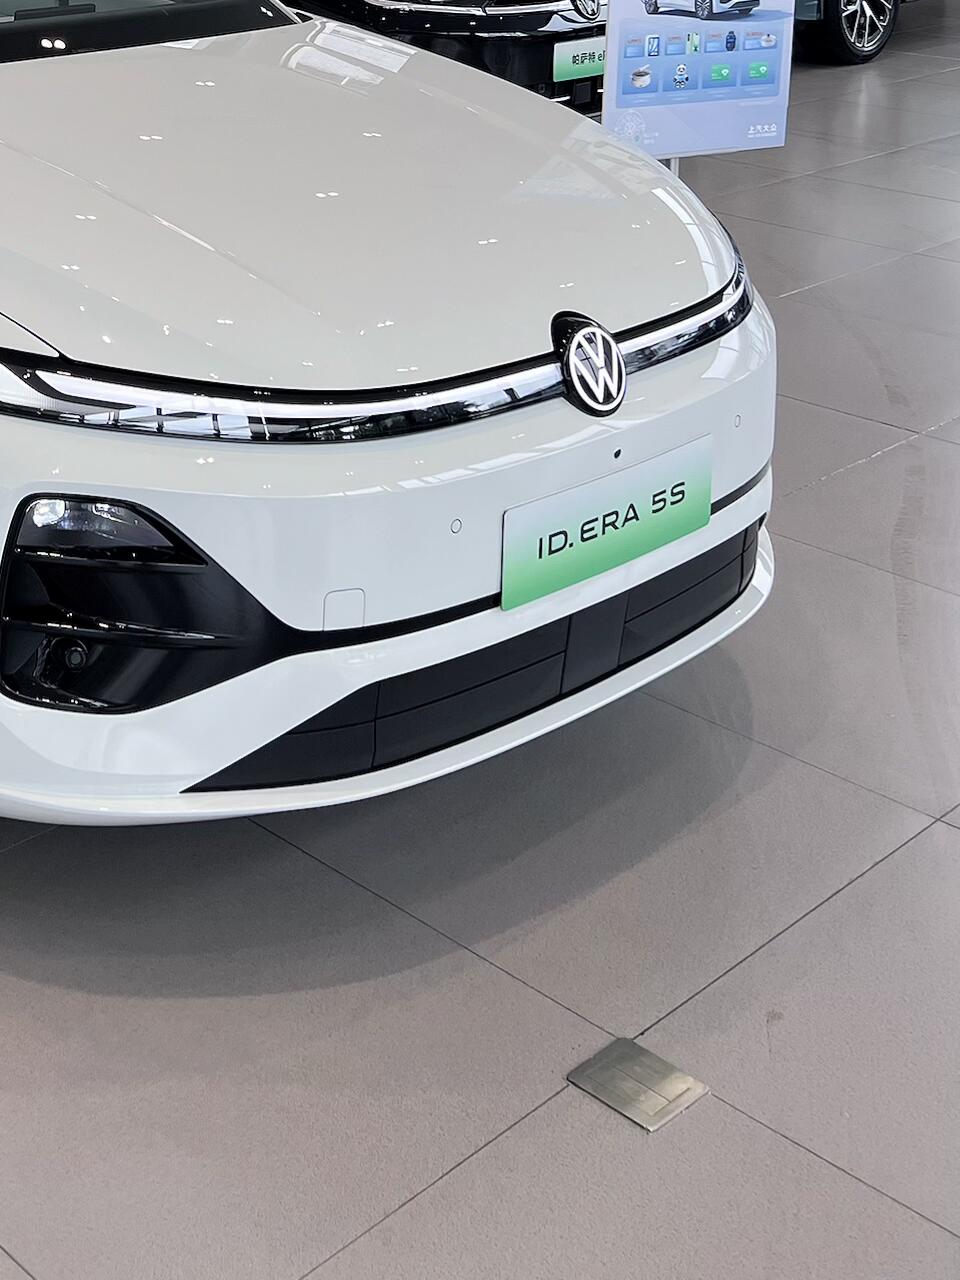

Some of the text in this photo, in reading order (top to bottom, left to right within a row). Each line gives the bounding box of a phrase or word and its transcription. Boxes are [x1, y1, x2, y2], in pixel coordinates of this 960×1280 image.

[572, 51, 596, 65] 帕萨特
[747, 123, 777, 134] 上汽大众
[538, 481, 686, 559] ID.ERA 5S
